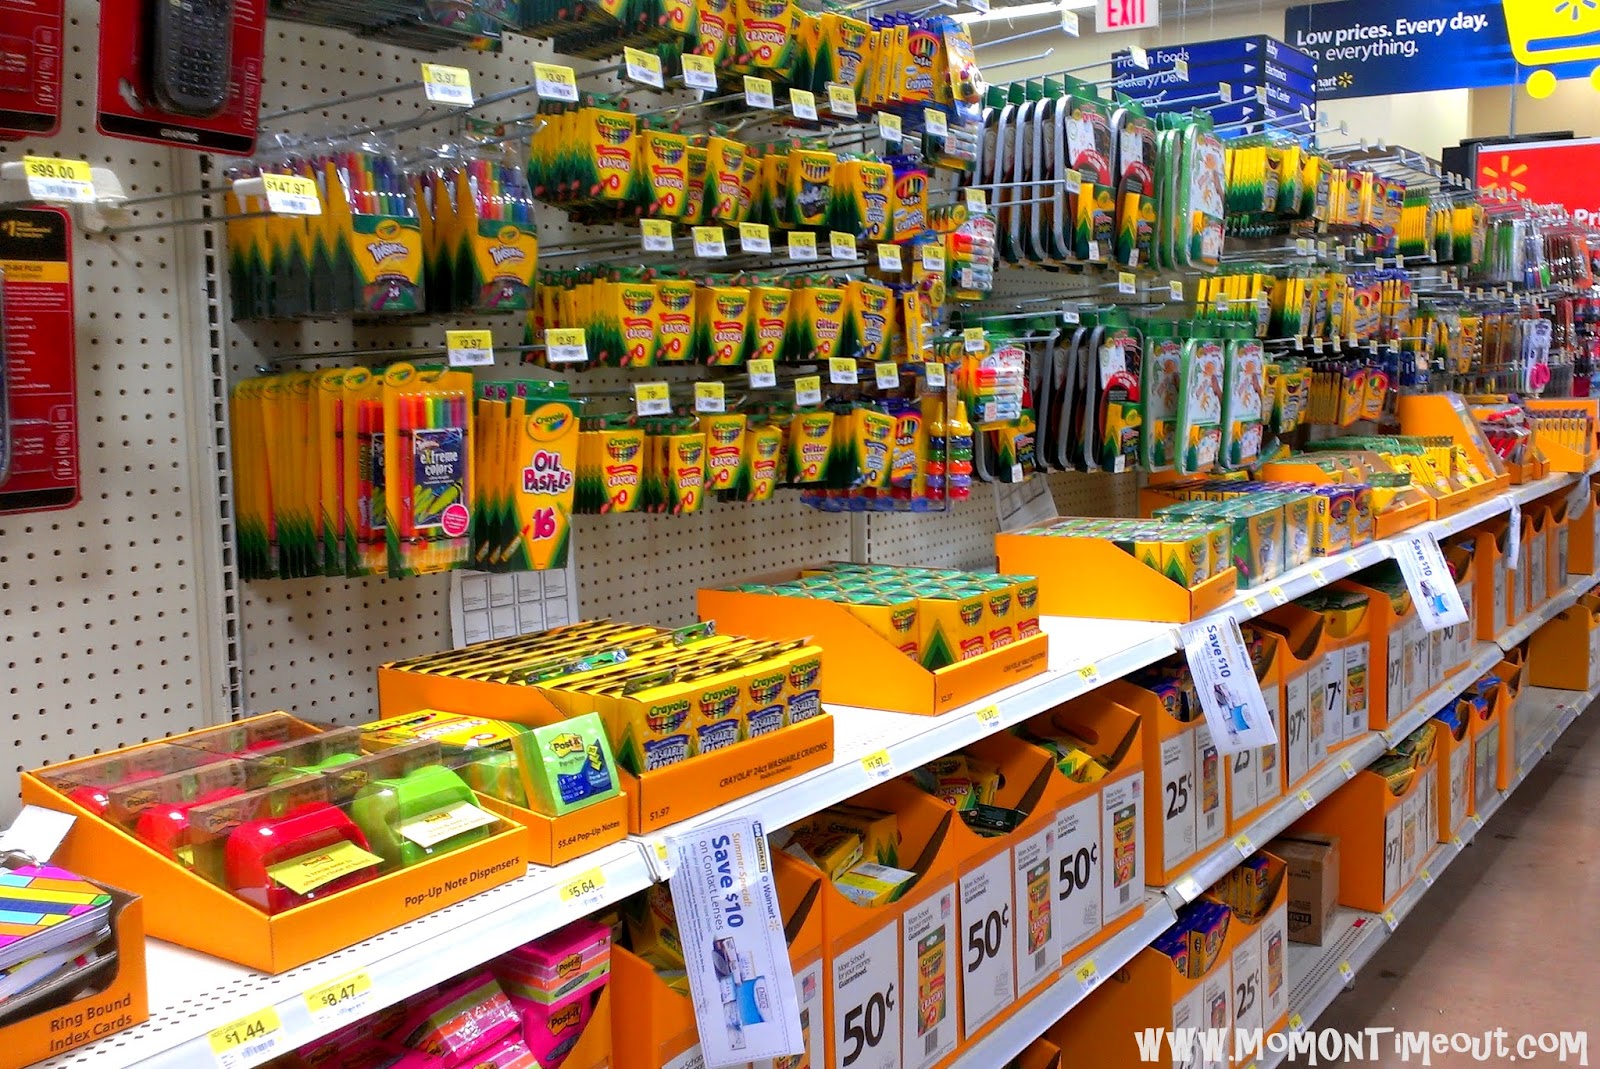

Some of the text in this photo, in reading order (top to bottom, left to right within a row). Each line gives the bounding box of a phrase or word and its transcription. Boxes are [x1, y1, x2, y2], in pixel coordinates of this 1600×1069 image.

[1107, 0, 1146, 27] EXIT
[745, 30, 786, 44] CRAYONS
[1296, 11, 1488, 46] Low prices. Every day.
[760, 47, 771, 58] 16
[1117, 46, 1189, 69] Fron Foods
[1325, 39, 1419, 62] everything.
[598, 115, 631, 128] Crayola
[653, 137, 683, 149] Crayola
[32, 163, 75, 180] $99.00
[598, 157, 630, 172] CRAYONS
[267, 179, 306, 195] $147.97
[654, 176, 684, 190] CRAYONS
[624, 288, 654, 299] Crayola
[660, 285, 690, 296] Crayola
[719, 295, 745, 304] Crayola
[817, 294, 842, 304] Crayola
[661, 323, 690, 334] CRAYONS
[816, 319, 839, 330] Glitter
[556, 335, 576, 346] $2.97
[625, 328, 653, 341] CRAYONS
[714, 332, 743, 343] CRAYONS
[460, 338, 483, 350] $2.97
[535, 413, 565, 425] Crayola
[714, 421, 742, 430] Crayola
[608, 438, 641, 447] Crayola
[679, 443, 702, 452] Crayola
[803, 444, 826, 454] Glitter
[424, 464, 454, 476] colors
[534, 451, 561, 471] OIL
[710, 456, 740, 467] CRAYONS
[523, 469, 573, 494] PASTELS
[608, 475, 637, 486] CRAYONS
[679, 477, 702, 488] CRAYONS
[532, 508, 556, 540] 16
[1411, 538, 1425, 560] Save
[1207, 625, 1222, 656] Save
[1219, 660, 1231, 678] $10
[790, 660, 820, 674] Crayola
[752, 673, 785, 689] Crayola
[702, 685, 739, 703] Crayola
[1326, 680, 1341, 711] 7¢
[650, 699, 689, 717] Crayola
[753, 765, 768, 777] 24ct
[767, 753, 800, 771] WASHABLE
[801, 742, 828, 759] CRAYONS
[868, 757, 884, 770] $1.97
[1166, 772, 1192, 821] 25¢
[649, 807, 671, 822] $1.97
[557, 820, 620, 850] $5.64 Pop-Up Notes
[732, 832, 745, 869] Summer
[755, 837, 768, 873] CONTACTS
[1059, 842, 1098, 899] 50¢
[405, 855, 520, 908] Pop-Up Note Dispensers
[569, 880, 596, 898] $5.64
[699, 840, 725, 931] on Contact Lenses
[712, 835, 744, 928] Save $10
[762, 884, 776, 920] Walmart
[908, 923, 931, 941] Guaranteed.
[967, 903, 1009, 974] 50¢
[559, 957, 580, 972] Post-it
[849, 951, 866, 966] School
[922, 949, 944, 967] Crayola
[838, 967, 868, 989] Guaranteed.
[322, 984, 357, 1007] $8.47
[920, 989, 945, 1013] CRAYONS
[1236, 968, 1259, 1020] 25¢
[50, 993, 132, 1033] Ring Bound
[551, 1009, 579, 1028] Post-it
[49, 1012, 132, 1053] Index Cards
[225, 1021, 266, 1044] $1.44
[842, 982, 895, 1068] 50¢
